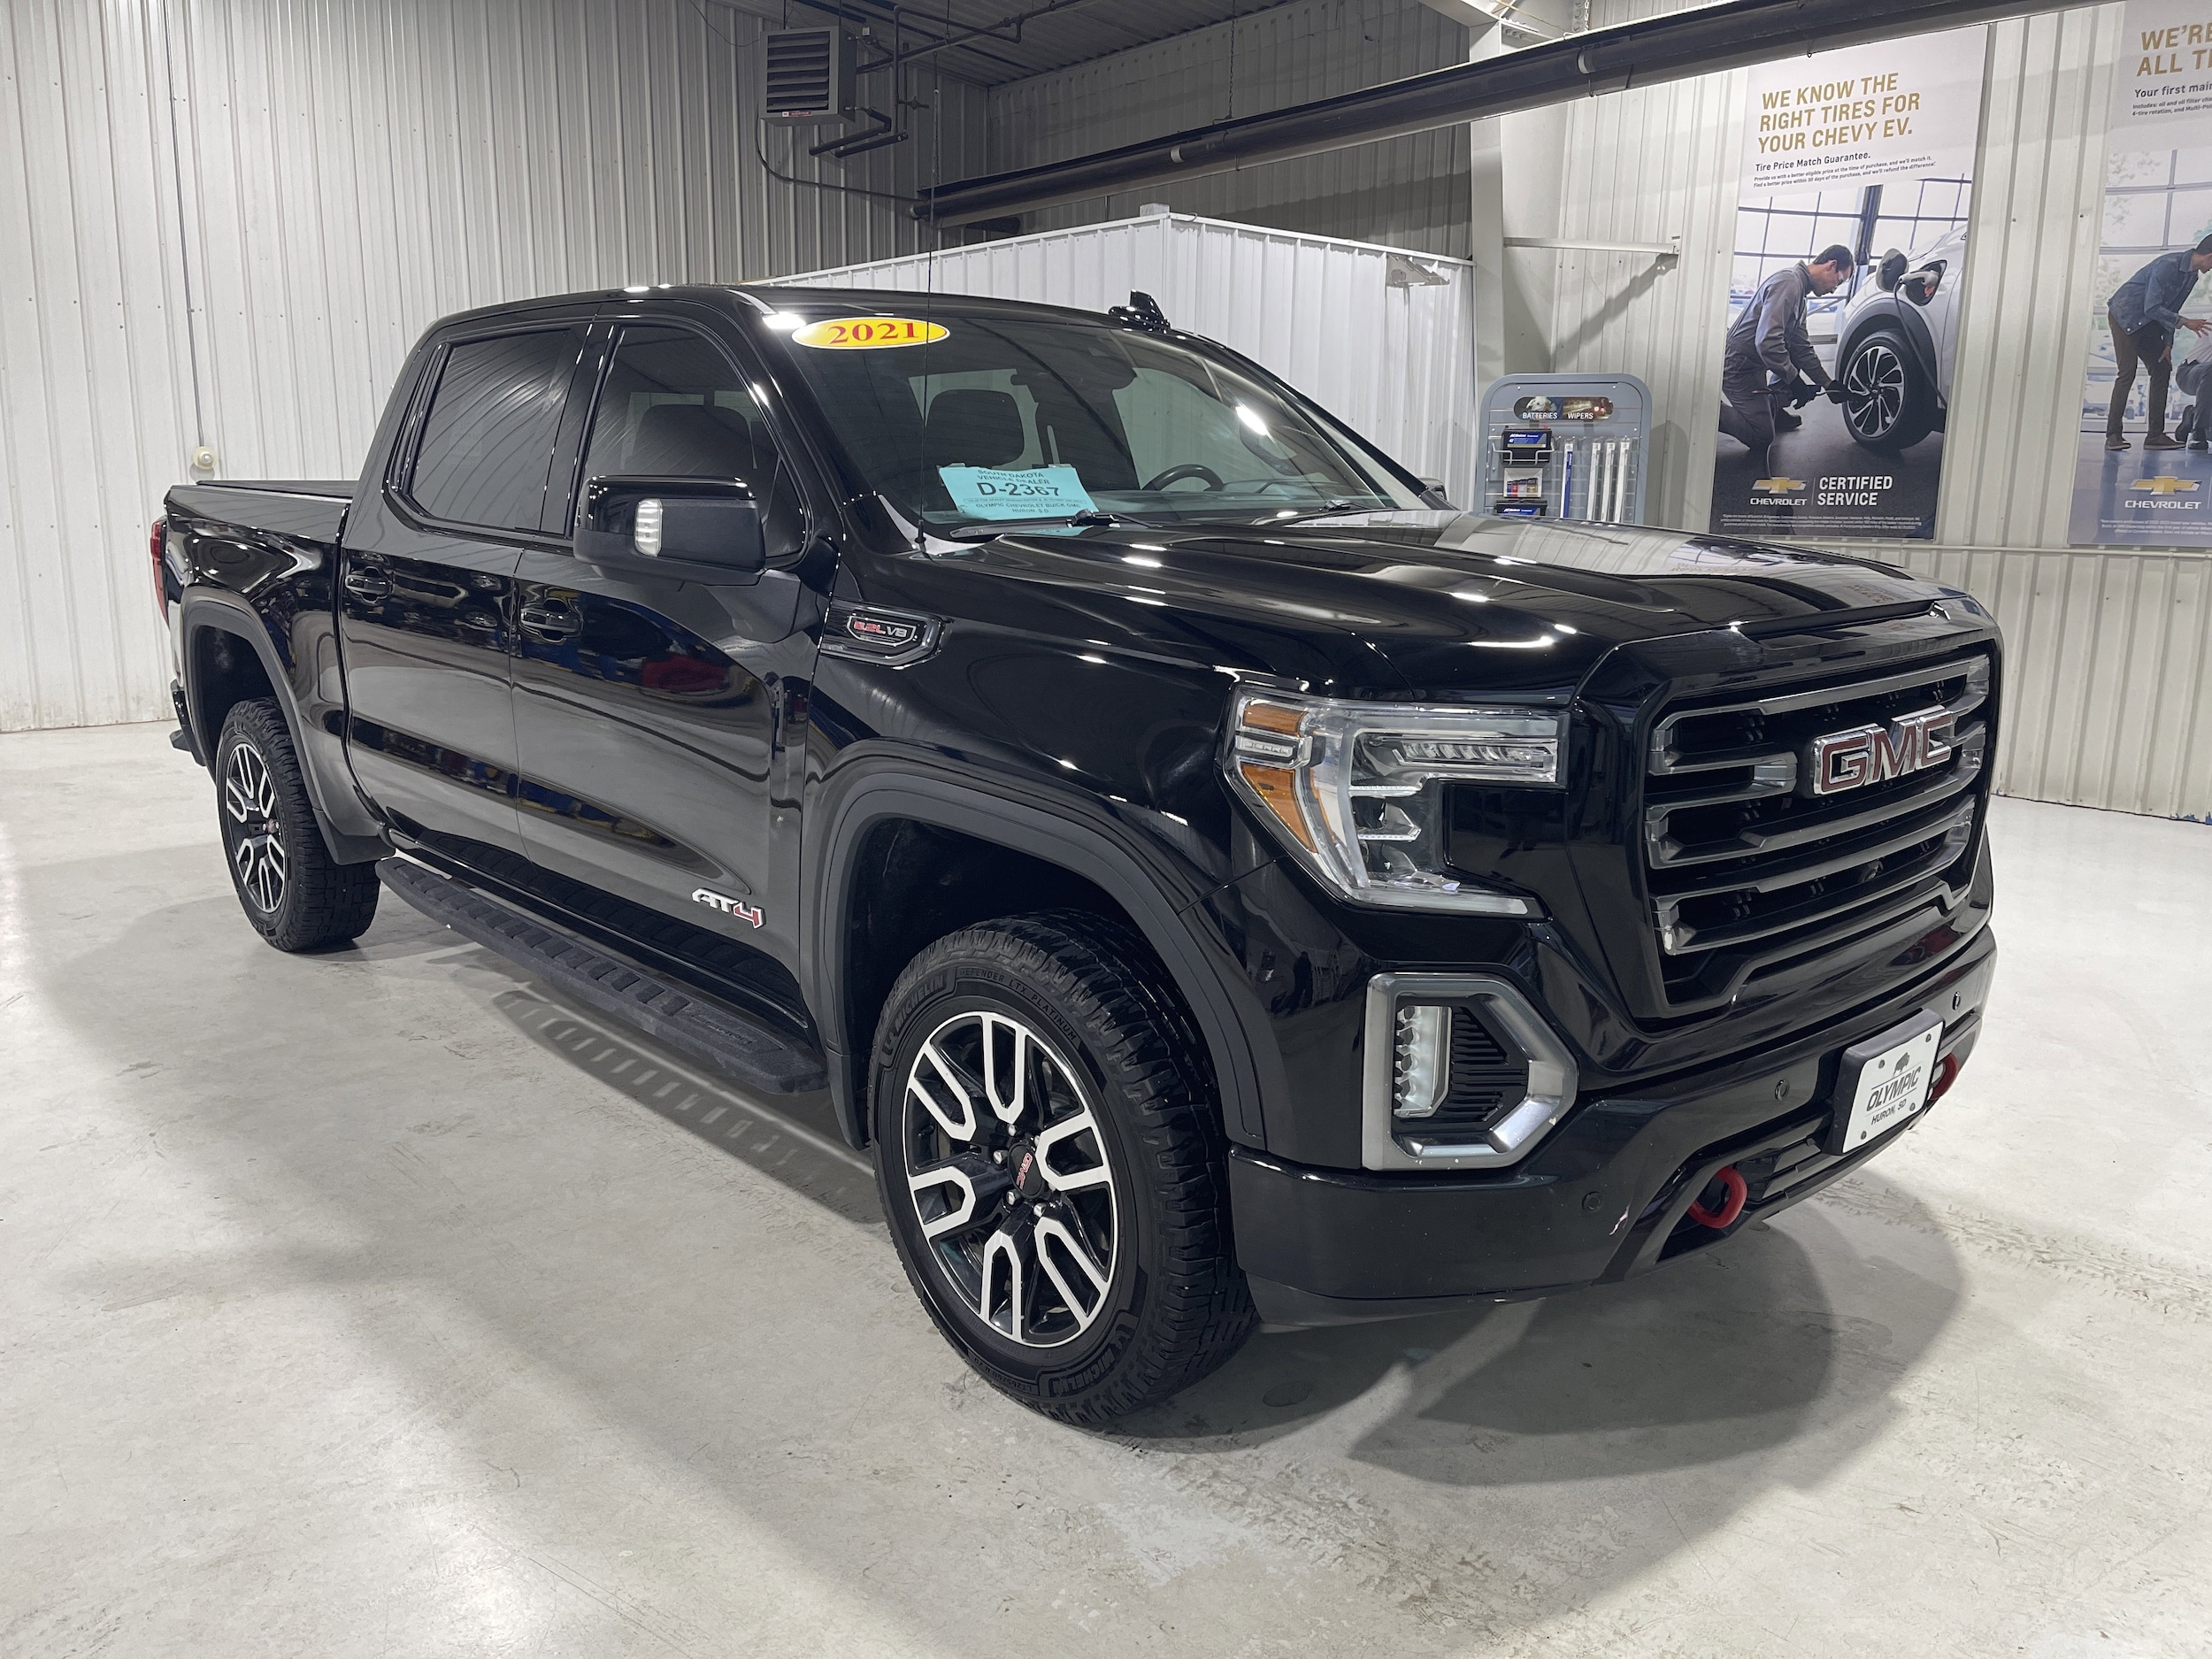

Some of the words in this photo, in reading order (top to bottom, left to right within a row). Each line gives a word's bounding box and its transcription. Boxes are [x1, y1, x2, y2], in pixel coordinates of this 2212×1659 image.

[2136, 53, 2183, 77] ALL
[1762, 89, 1792, 110] WE
[1796, 80, 1855, 105] KNOW
[1861, 72, 1899, 96] THE
[2134, 88, 2159, 98] Your
[2162, 85, 2185, 96] first
[1759, 108, 1816, 132] RIGHT
[1821, 99, 1876, 124] TIRES
[1881, 92, 1920, 115] FOR
[1758, 132, 1806, 154] YOUR
[1811, 121, 1878, 148] CHEVY
[1883, 117, 1913, 138] EV.
[1755, 163, 1771, 172] Tire
[1773, 161, 1794, 170] Price
[1796, 157, 1822, 168] Match
[1824, 152, 1871, 165] Guarantee.
[827, 322, 919, 345] 2021
[976, 482, 1059, 496] D-2367
[1818, 475, 1893, 490] CERTIFIED
[1749, 497, 1808, 506] CHEVROLET
[1816, 492, 1878, 506] SERVICE
[2124, 500, 2202, 510] CHEVROLET
[887, 626, 908, 637] V8
[1814, 710, 1954, 795] GMC
[691, 887, 764, 929] AT4
[895, 973, 944, 1033] MICHELIN
[959, 967, 1004, 982] DEFENDER
[1008, 979, 1026, 995] LTX
[1030, 994, 1077, 1041] PLATINUM
[1866, 1065, 1922, 1112] OLYMPIC
[1897, 1099, 1907, 1111] SD
[1016, 1152, 1033, 1191] GMC
[1052, 1347, 1116, 1394] MICHELIN
